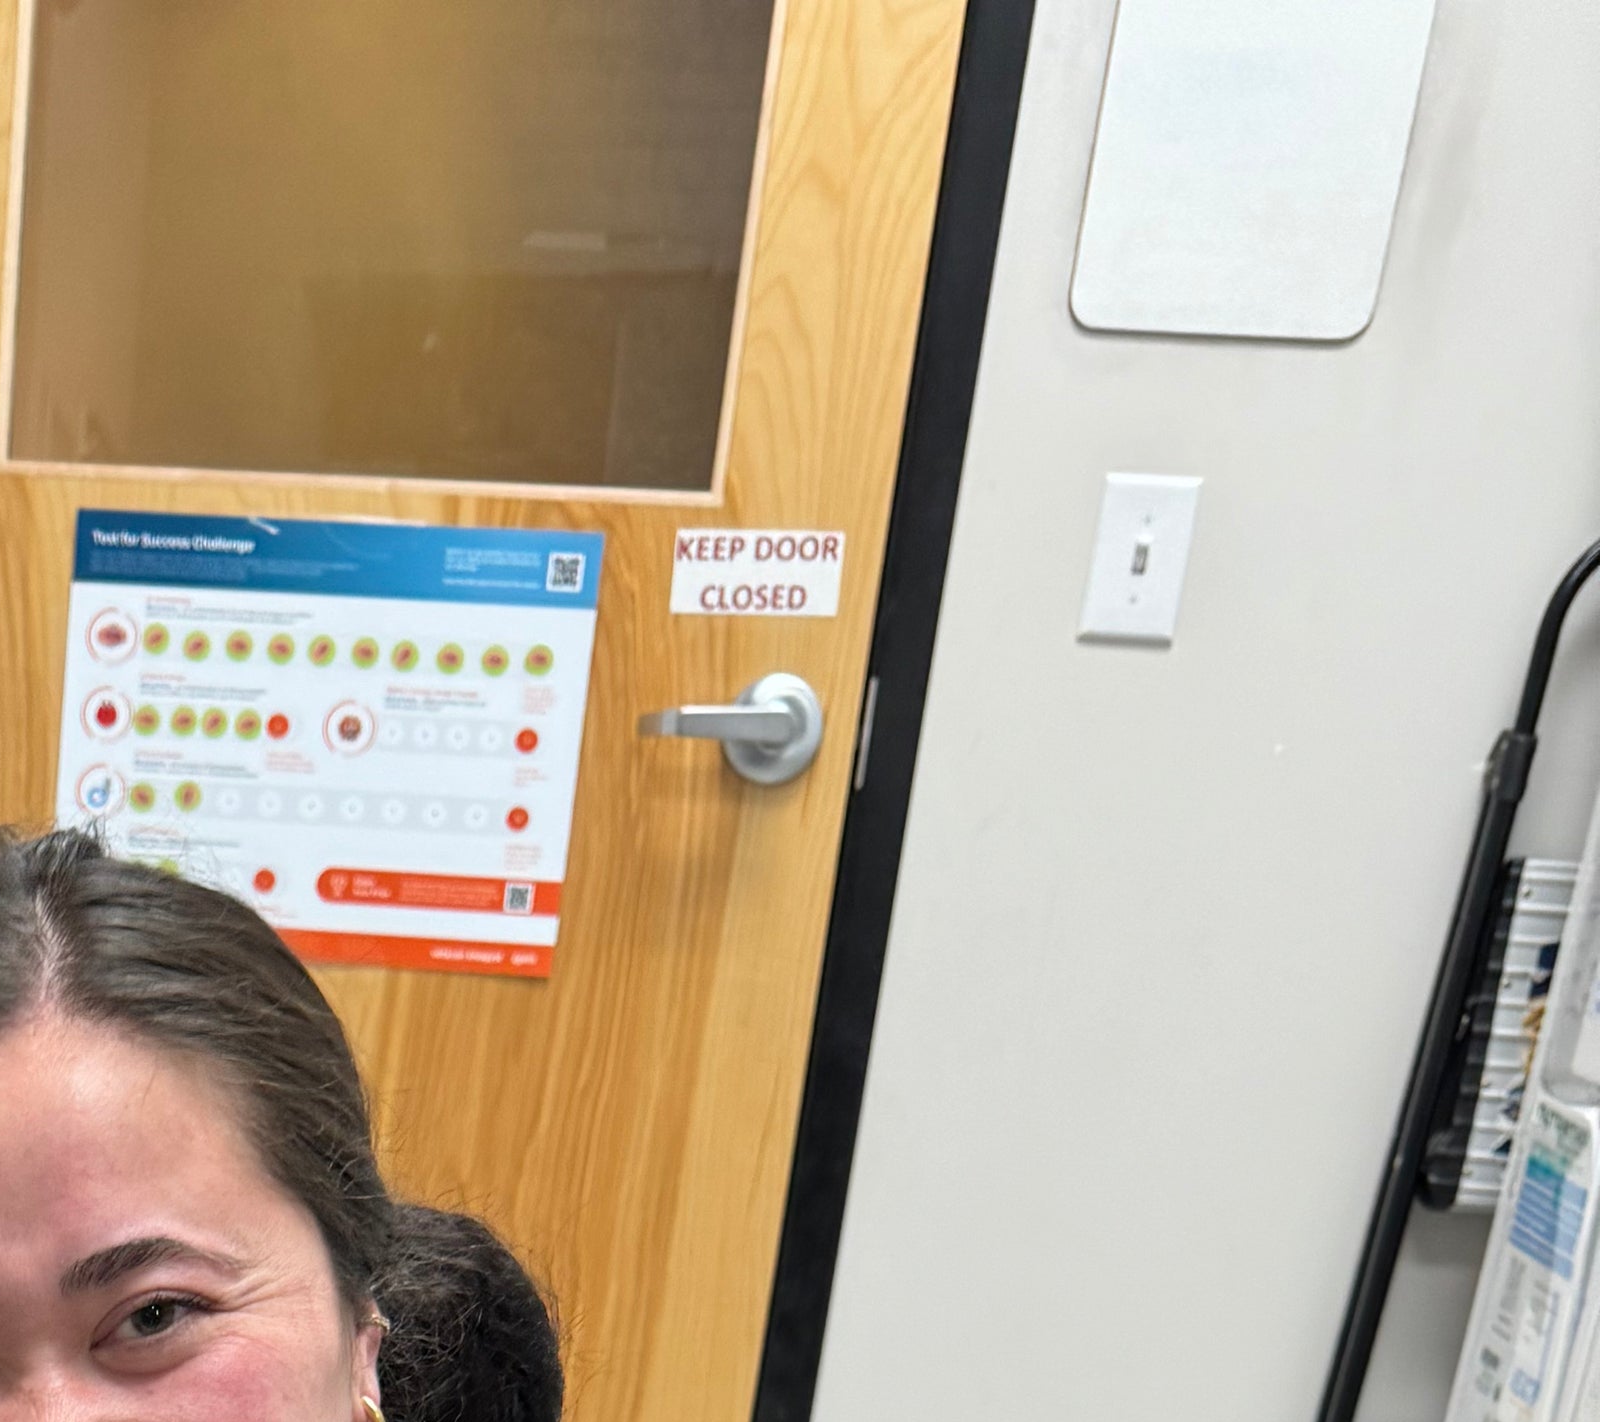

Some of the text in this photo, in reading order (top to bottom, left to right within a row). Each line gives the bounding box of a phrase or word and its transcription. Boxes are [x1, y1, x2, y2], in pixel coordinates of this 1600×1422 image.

[676, 536, 839, 561] KEEP DOOR
[700, 584, 807, 610] CLOSED
